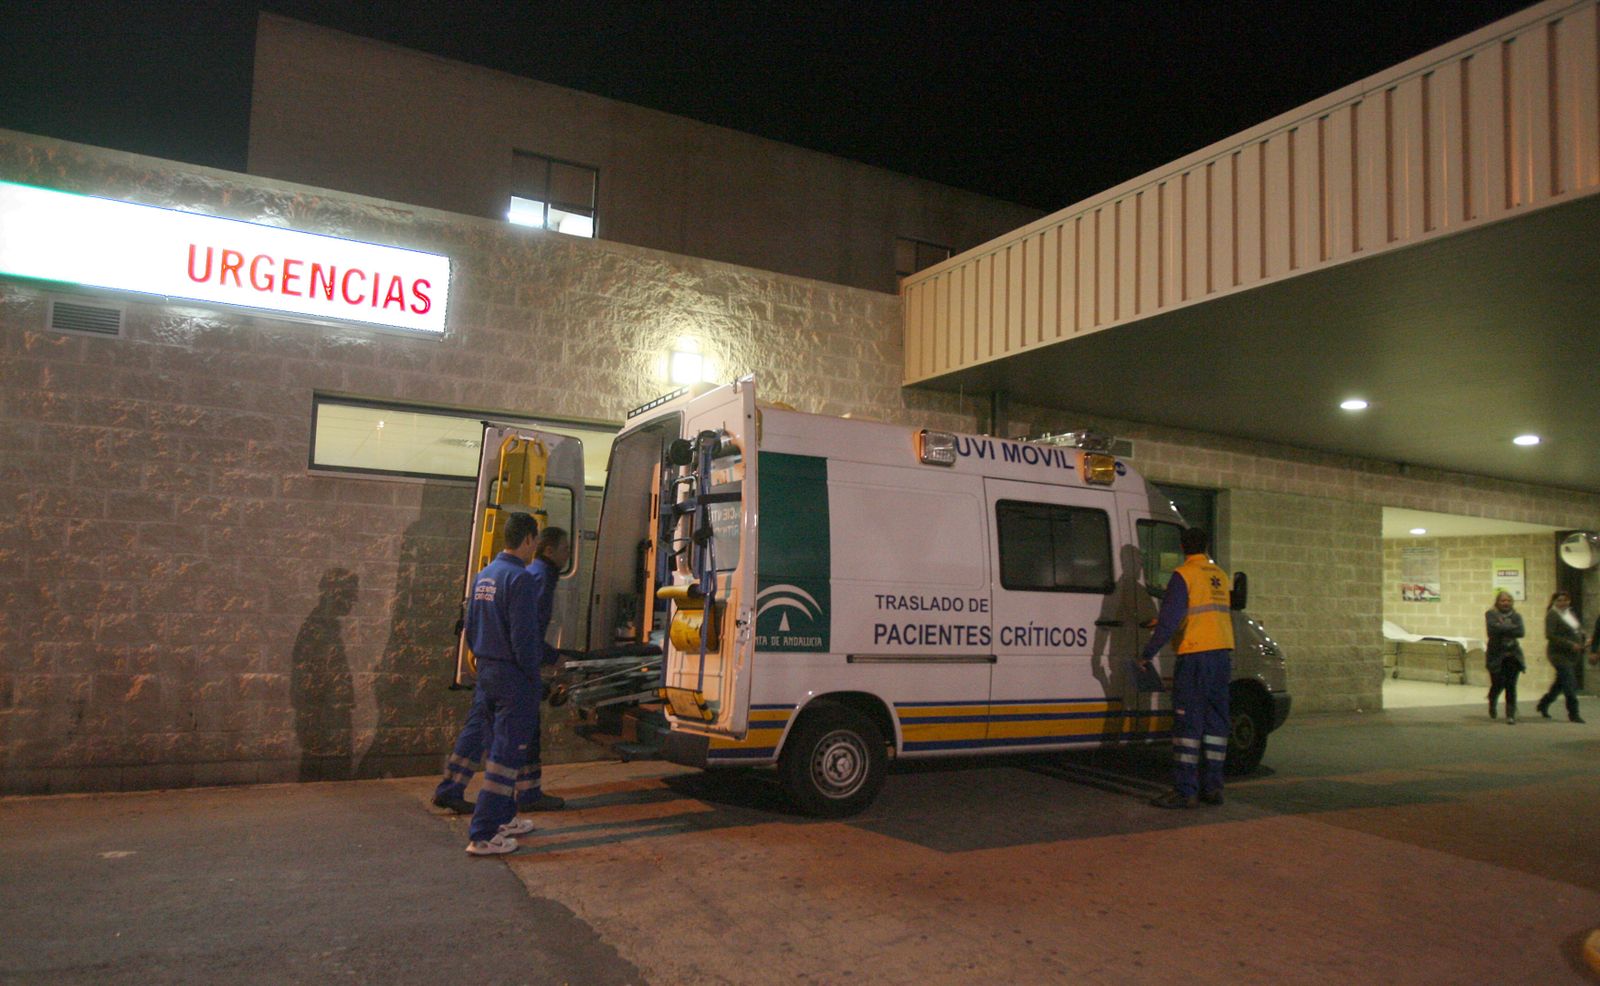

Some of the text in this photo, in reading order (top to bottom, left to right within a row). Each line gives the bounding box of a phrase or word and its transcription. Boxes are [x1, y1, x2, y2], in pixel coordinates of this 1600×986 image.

[187, 244, 432, 315] URGENCIAS
[955, 436, 1075, 469] UVI MOVIL
[875, 594, 989, 613] TRASLADO DE
[771, 636, 780, 647] DE
[874, 621, 1088, 647] PACIENTES CRÍTICOS
